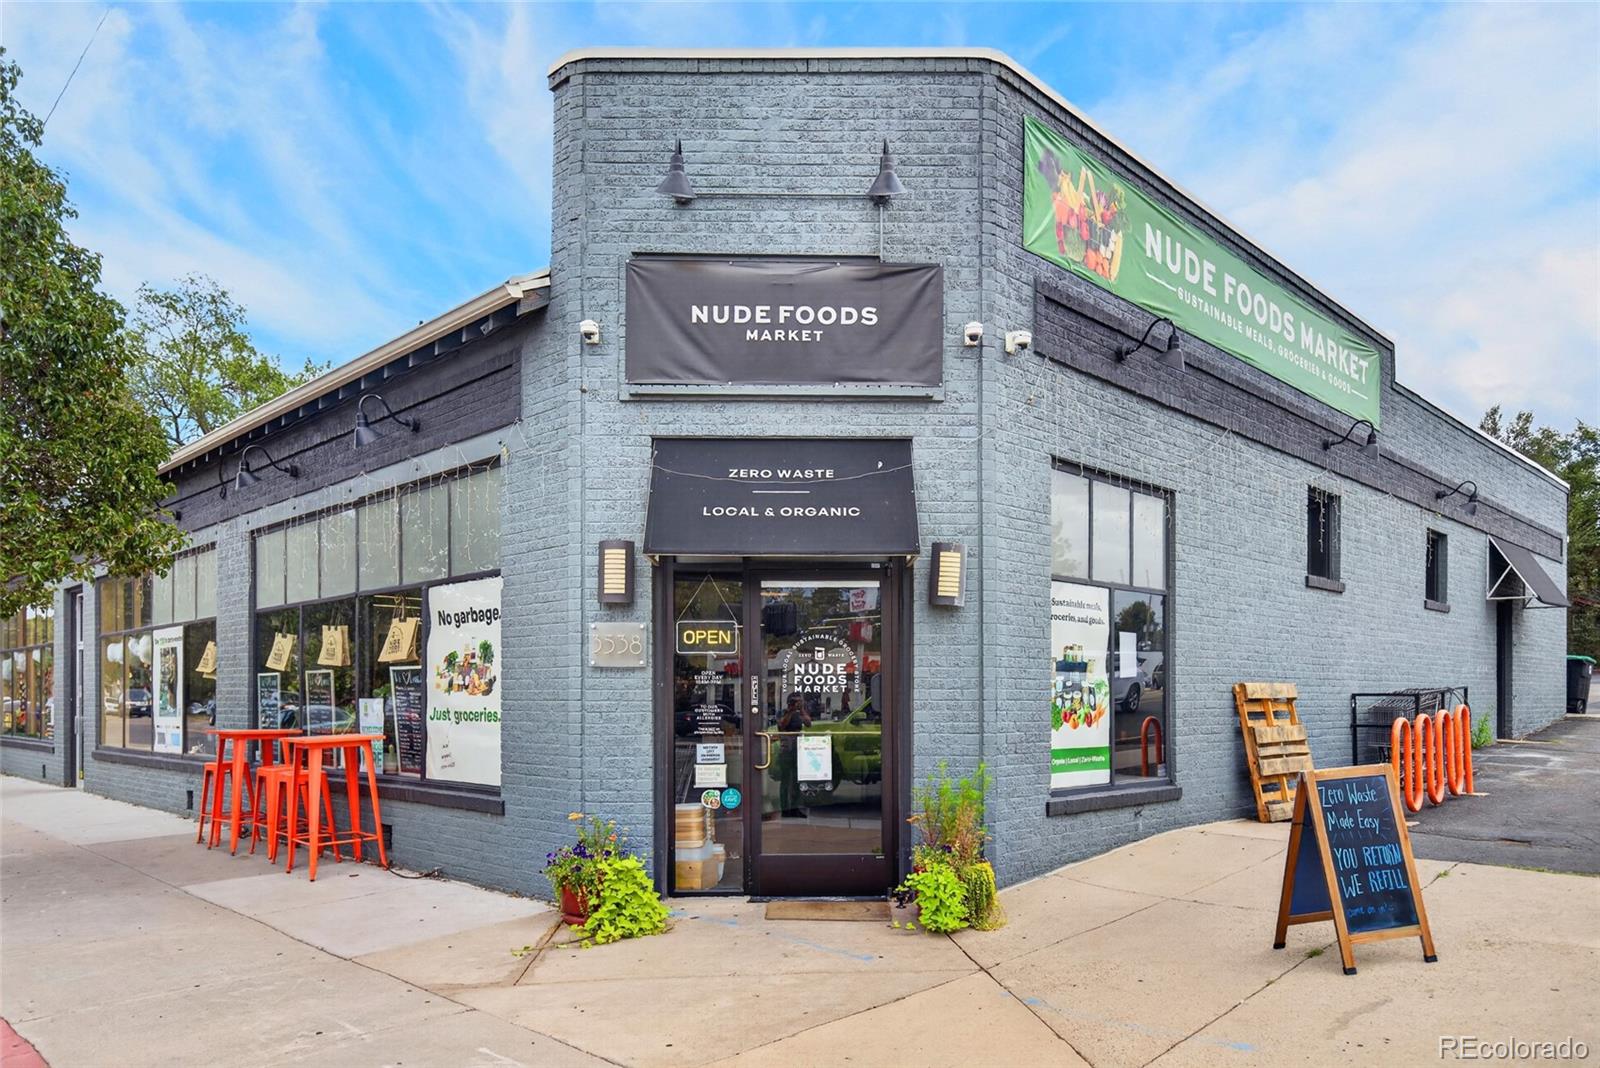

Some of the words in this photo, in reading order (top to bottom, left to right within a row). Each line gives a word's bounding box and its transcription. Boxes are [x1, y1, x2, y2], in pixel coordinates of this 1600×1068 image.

[1145, 222, 1217, 297] NUDE
[1224, 272, 1296, 343] FOODS
[1301, 321, 1369, 385] MARKET
[691, 304, 771, 325] NUDE
[778, 305, 879, 326] FOODS
[746, 329, 824, 342] MARKET
[1177, 286, 1243, 334] SUSTAINABLE
[1245, 323, 1276, 353] MEALS,
[1278, 344, 1320, 377] GROCERIES
[1328, 372, 1351, 393] GOODS
[728, 468, 773, 479] ZERO
[777, 469, 835, 479] WASTE
[703, 506, 760, 517] LOCAL
[764, 507, 775, 517] &
[780, 507, 861, 518] ORGANIC
[438, 609, 452, 627] No
[453, 606, 502, 629] garbage.
[683, 629, 731, 645] OPEN
[792, 633, 838, 650] SUSTAINABLE
[838, 639, 859, 668] GROCERY
[794, 663, 847, 675] NUDE
[794, 675, 847, 685] FOODS
[794, 685, 848, 693] MARKET
[430, 707, 451, 722] Just
[453, 707, 501, 725] groceries.
[1317, 786, 1344, 808] Zero
[1346, 782, 1378, 805] Waste
[1326, 810, 1355, 831] Made
[1356, 809, 1380, 834] Easy
[1333, 847, 1359, 871] YOU
[1340, 874, 1364, 899] WE
[1368, 868, 1408, 893] REFILL
